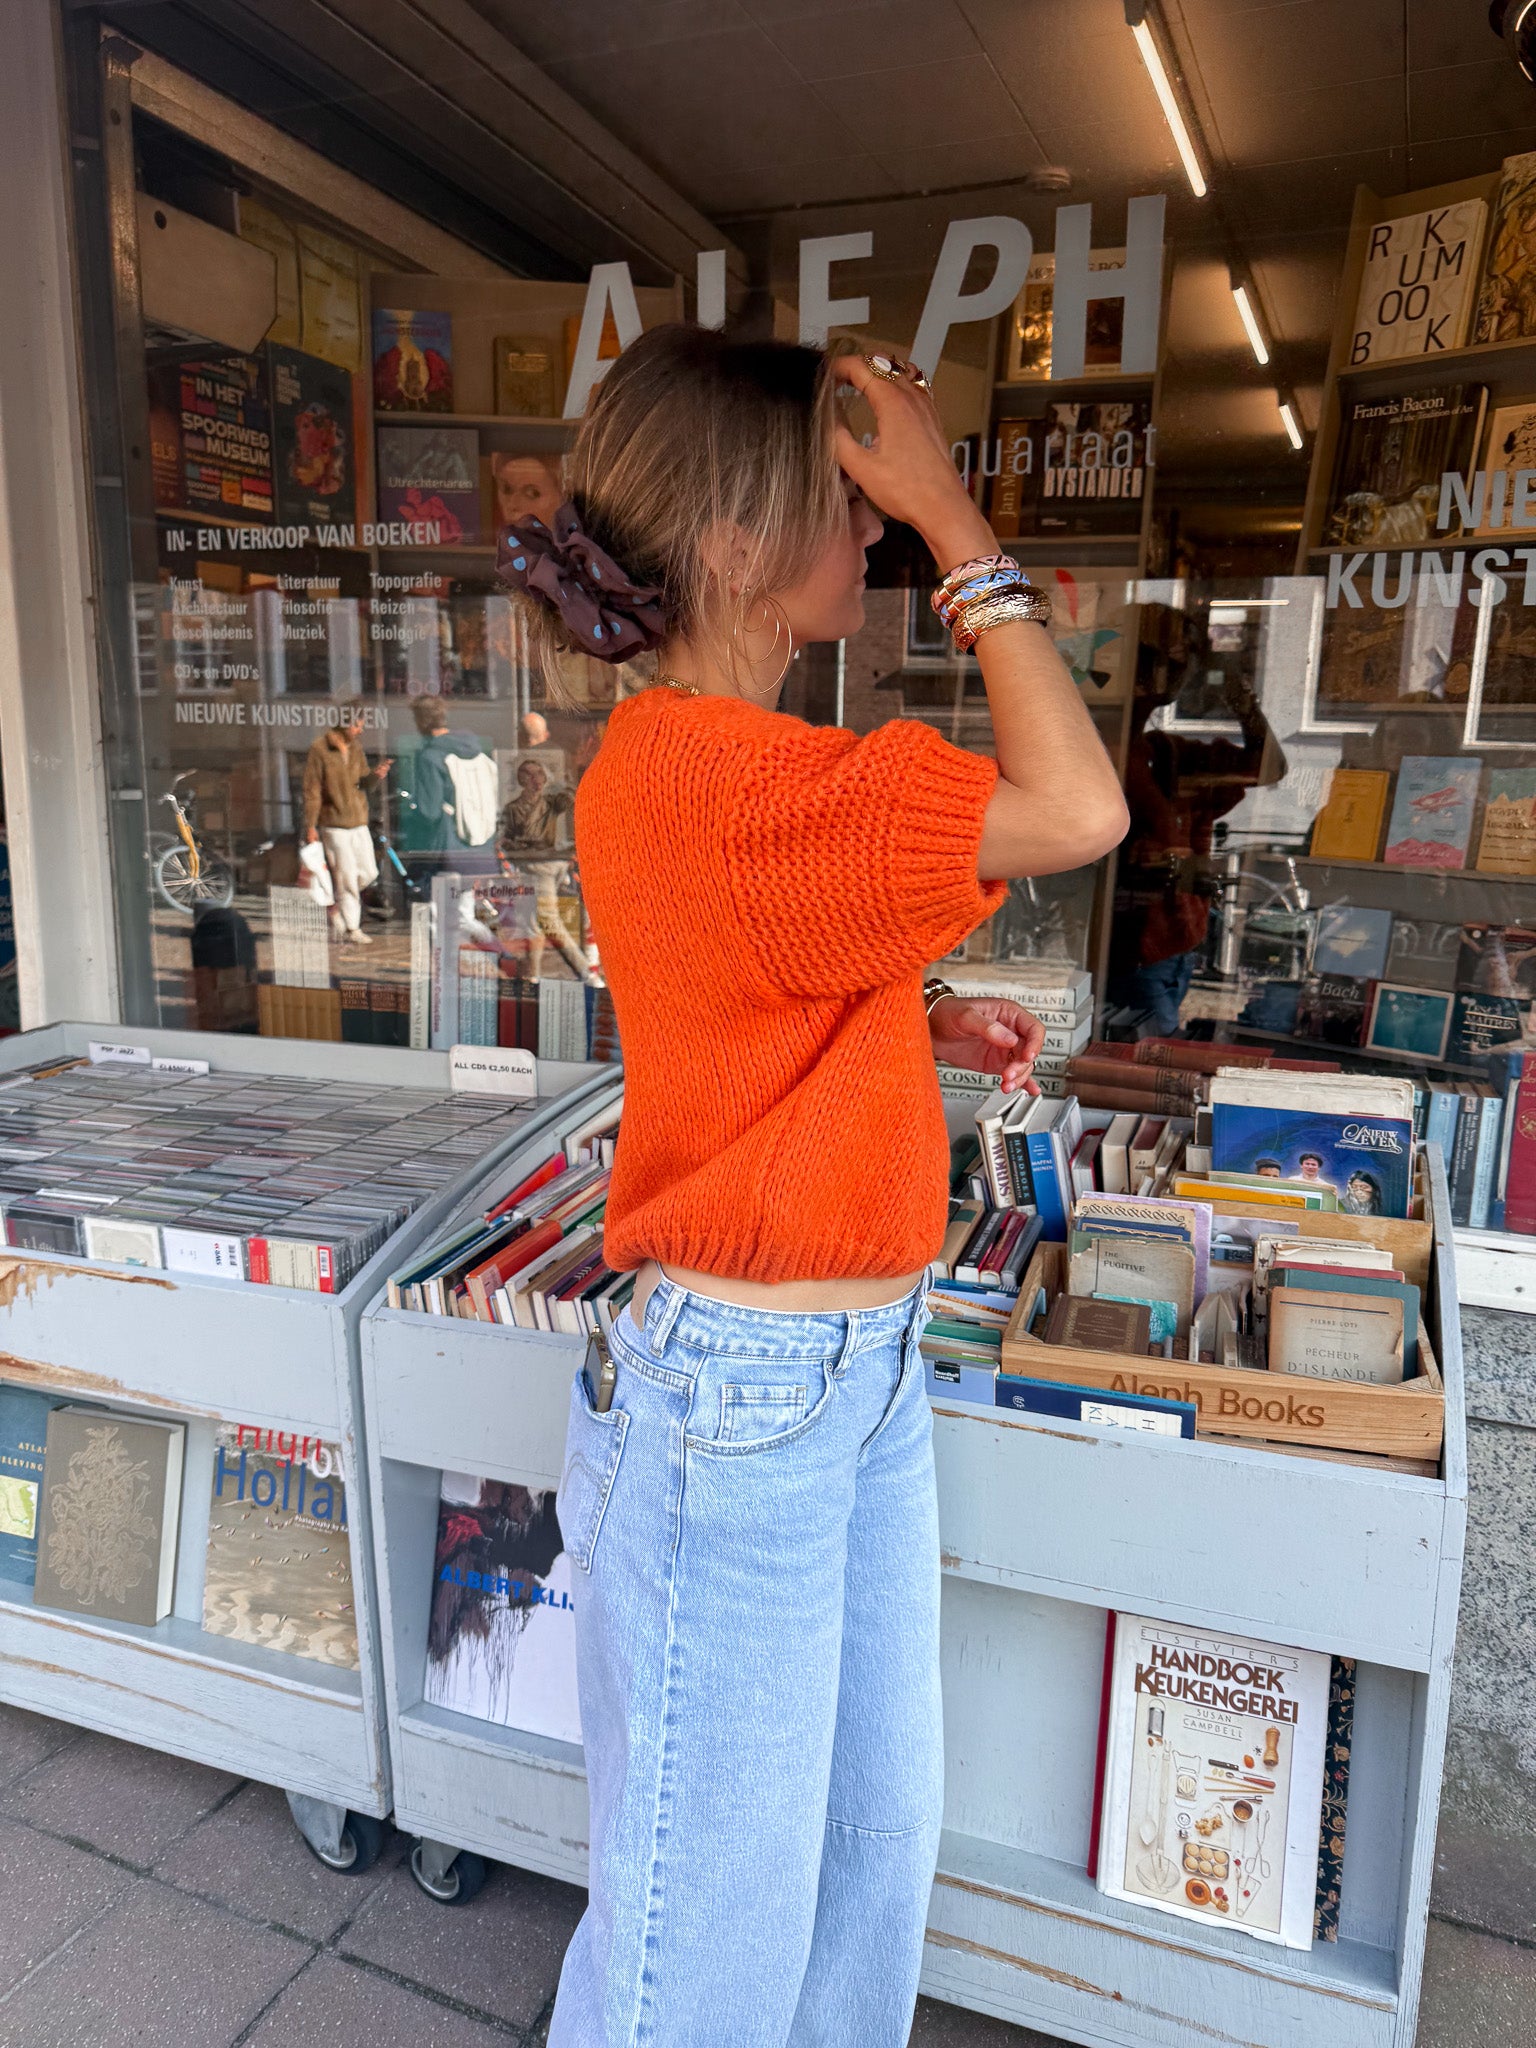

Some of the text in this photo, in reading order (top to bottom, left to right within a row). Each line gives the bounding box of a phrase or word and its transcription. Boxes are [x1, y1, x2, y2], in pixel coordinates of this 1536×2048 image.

[1353, 396, 1445, 420] Francis Bacon
[181, 411, 270, 449] SPOORWEG
[206, 437, 271, 468] MUSEUM
[1043, 467, 1144, 498] BYSTANDER
[998, 493, 1017, 518] Jan
[198, 528, 221, 551] EN
[227, 525, 309, 550] VERKOOP
[315, 523, 355, 547] VAN
[362, 521, 441, 547] BOEKEN
[169, 576, 204, 592] Kunst
[277, 573, 341, 590] Literatuur
[369, 570, 442, 592] Topografie
[172, 601, 248, 616] Architectuur
[280, 599, 333, 615] Filosofie
[370, 599, 415, 615] Reizen
[172, 625, 253, 641] Geschiedenis
[280, 624, 327, 641] Muziek
[371, 623, 426, 644] Biologie
[223, 664, 259, 681] DVD's
[176, 702, 389, 729] NIEUWE KUNSTBOEKEN
[1321, 981, 1361, 999] Bach
[1036, 1012, 1068, 1023] MAN
[488, 1065, 510, 1073] €2,50
[511, 1066, 533, 1074] EACH
[1014, 1139, 1030, 1198] HANDBOEK
[1103, 1259, 1146, 1273] FUGITIVE
[1287, 1361, 1378, 1382] D'ISLANDE
[1110, 1373, 1203, 1413] Aleph
[1218, 1387, 1325, 1428] Books
[439, 1563, 525, 1599] ALBERT
[1140, 1627, 1299, 1669] ELSEVIERS
[1150, 1644, 1285, 1694] HANDBOEK
[1134, 1662, 1299, 1725] KEUKENGEREI
[1196, 1708, 1232, 1723] SUSAN
[1182, 1717, 1243, 1739] CAMPBELL
